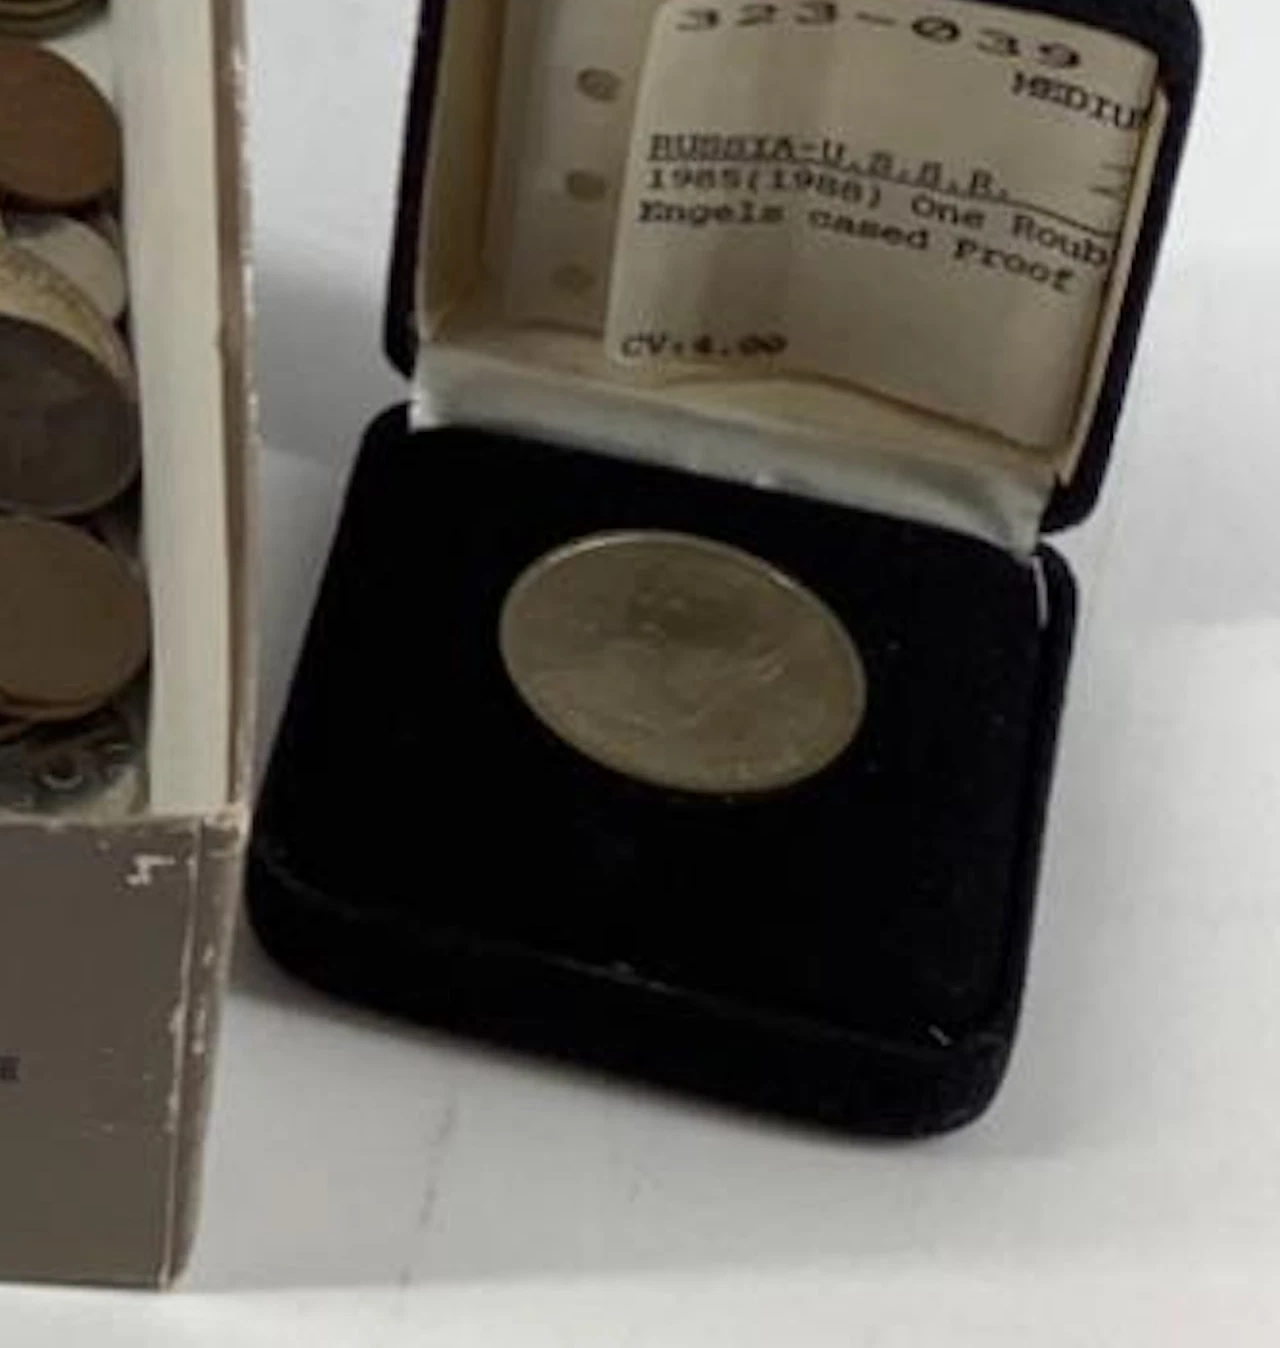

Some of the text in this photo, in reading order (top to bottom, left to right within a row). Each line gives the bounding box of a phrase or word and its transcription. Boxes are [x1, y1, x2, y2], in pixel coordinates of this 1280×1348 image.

[675, 0, 1081, 69] 323-039
[638, 200, 1075, 293] Engels cased Proof
[911, 193, 985, 229] One
[1010, 213, 1108, 266] Roub
